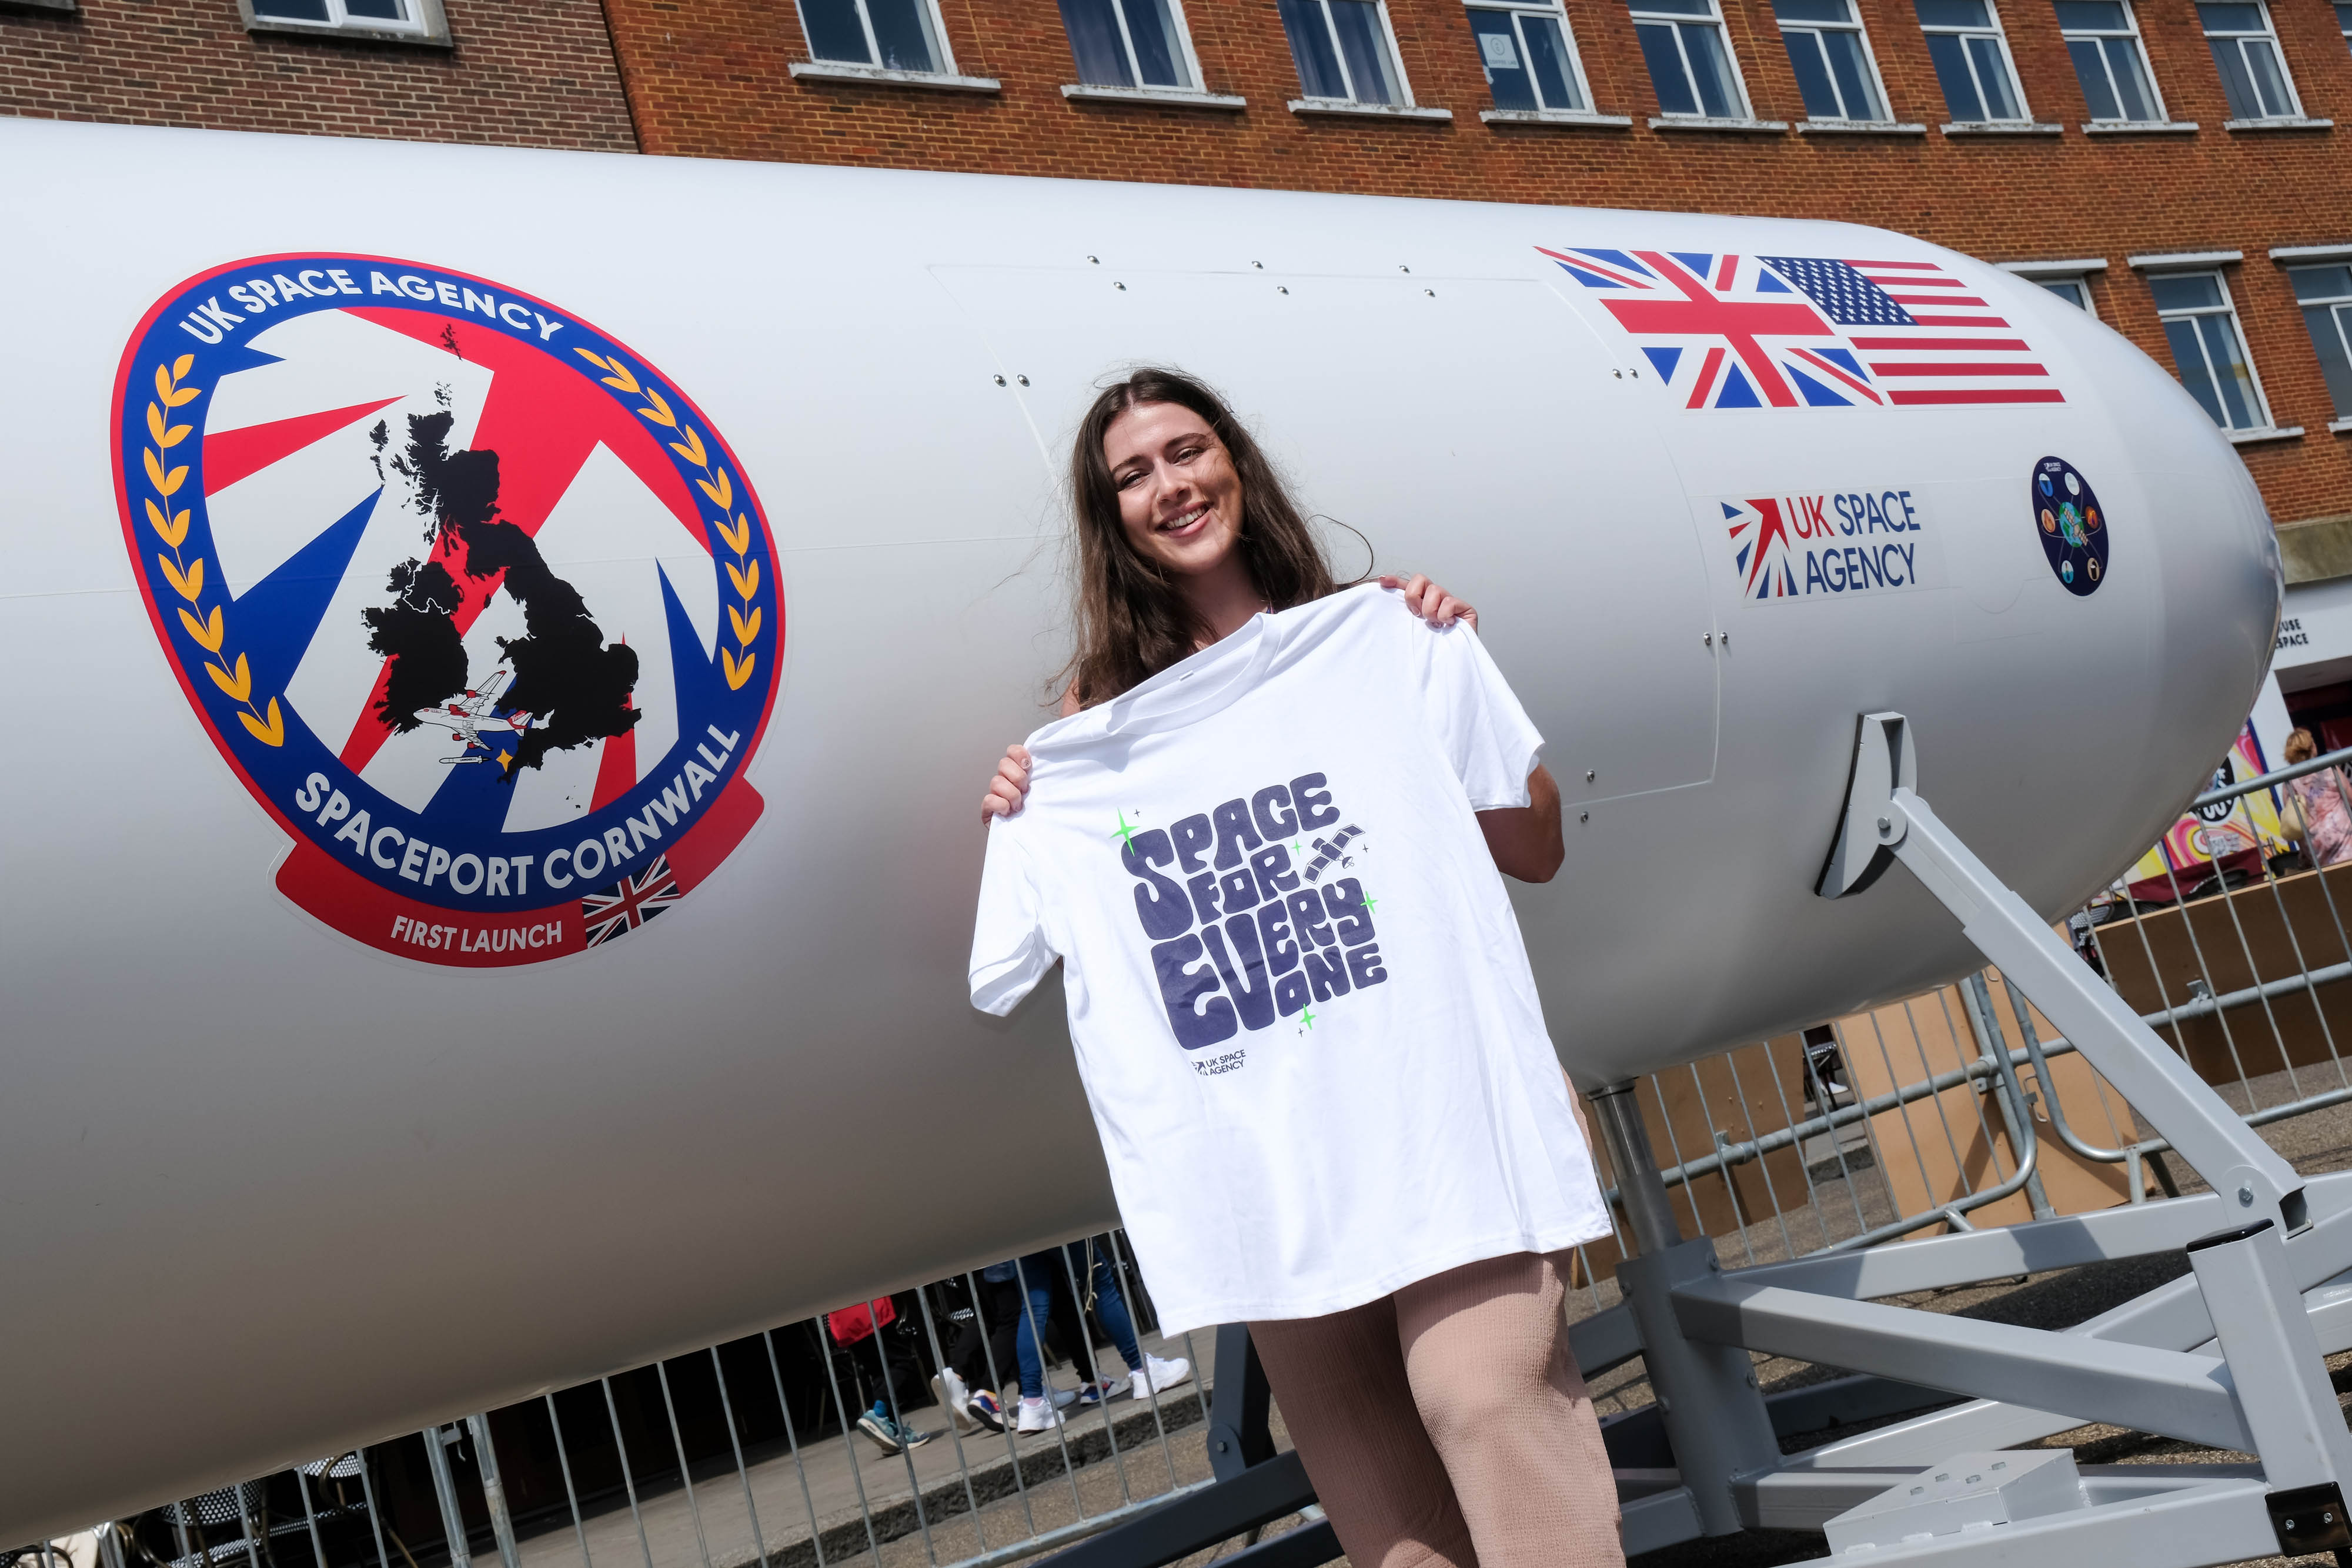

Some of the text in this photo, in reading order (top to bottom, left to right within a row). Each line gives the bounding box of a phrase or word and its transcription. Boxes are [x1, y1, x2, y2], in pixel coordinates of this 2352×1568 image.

[179, 269, 563, 345] UK SPACE AGENCY
[1786, 491, 1921, 539] UK SPACE
[1807, 543, 1915, 595] AGENCY
[295, 724, 741, 896] SPACEPORT CORNWALL
[1121, 772, 1341, 941] SPACE
[1187, 844, 1301, 925] FOR
[390, 915, 562, 952] FIRST LAUNCH
[1151, 877, 1376, 1050] EVERY
[1274, 942, 1388, 1018] ONE
[1205, 1049, 1246, 1067] UK SPACE
[1210, 1059, 1244, 1075] AGENCY
